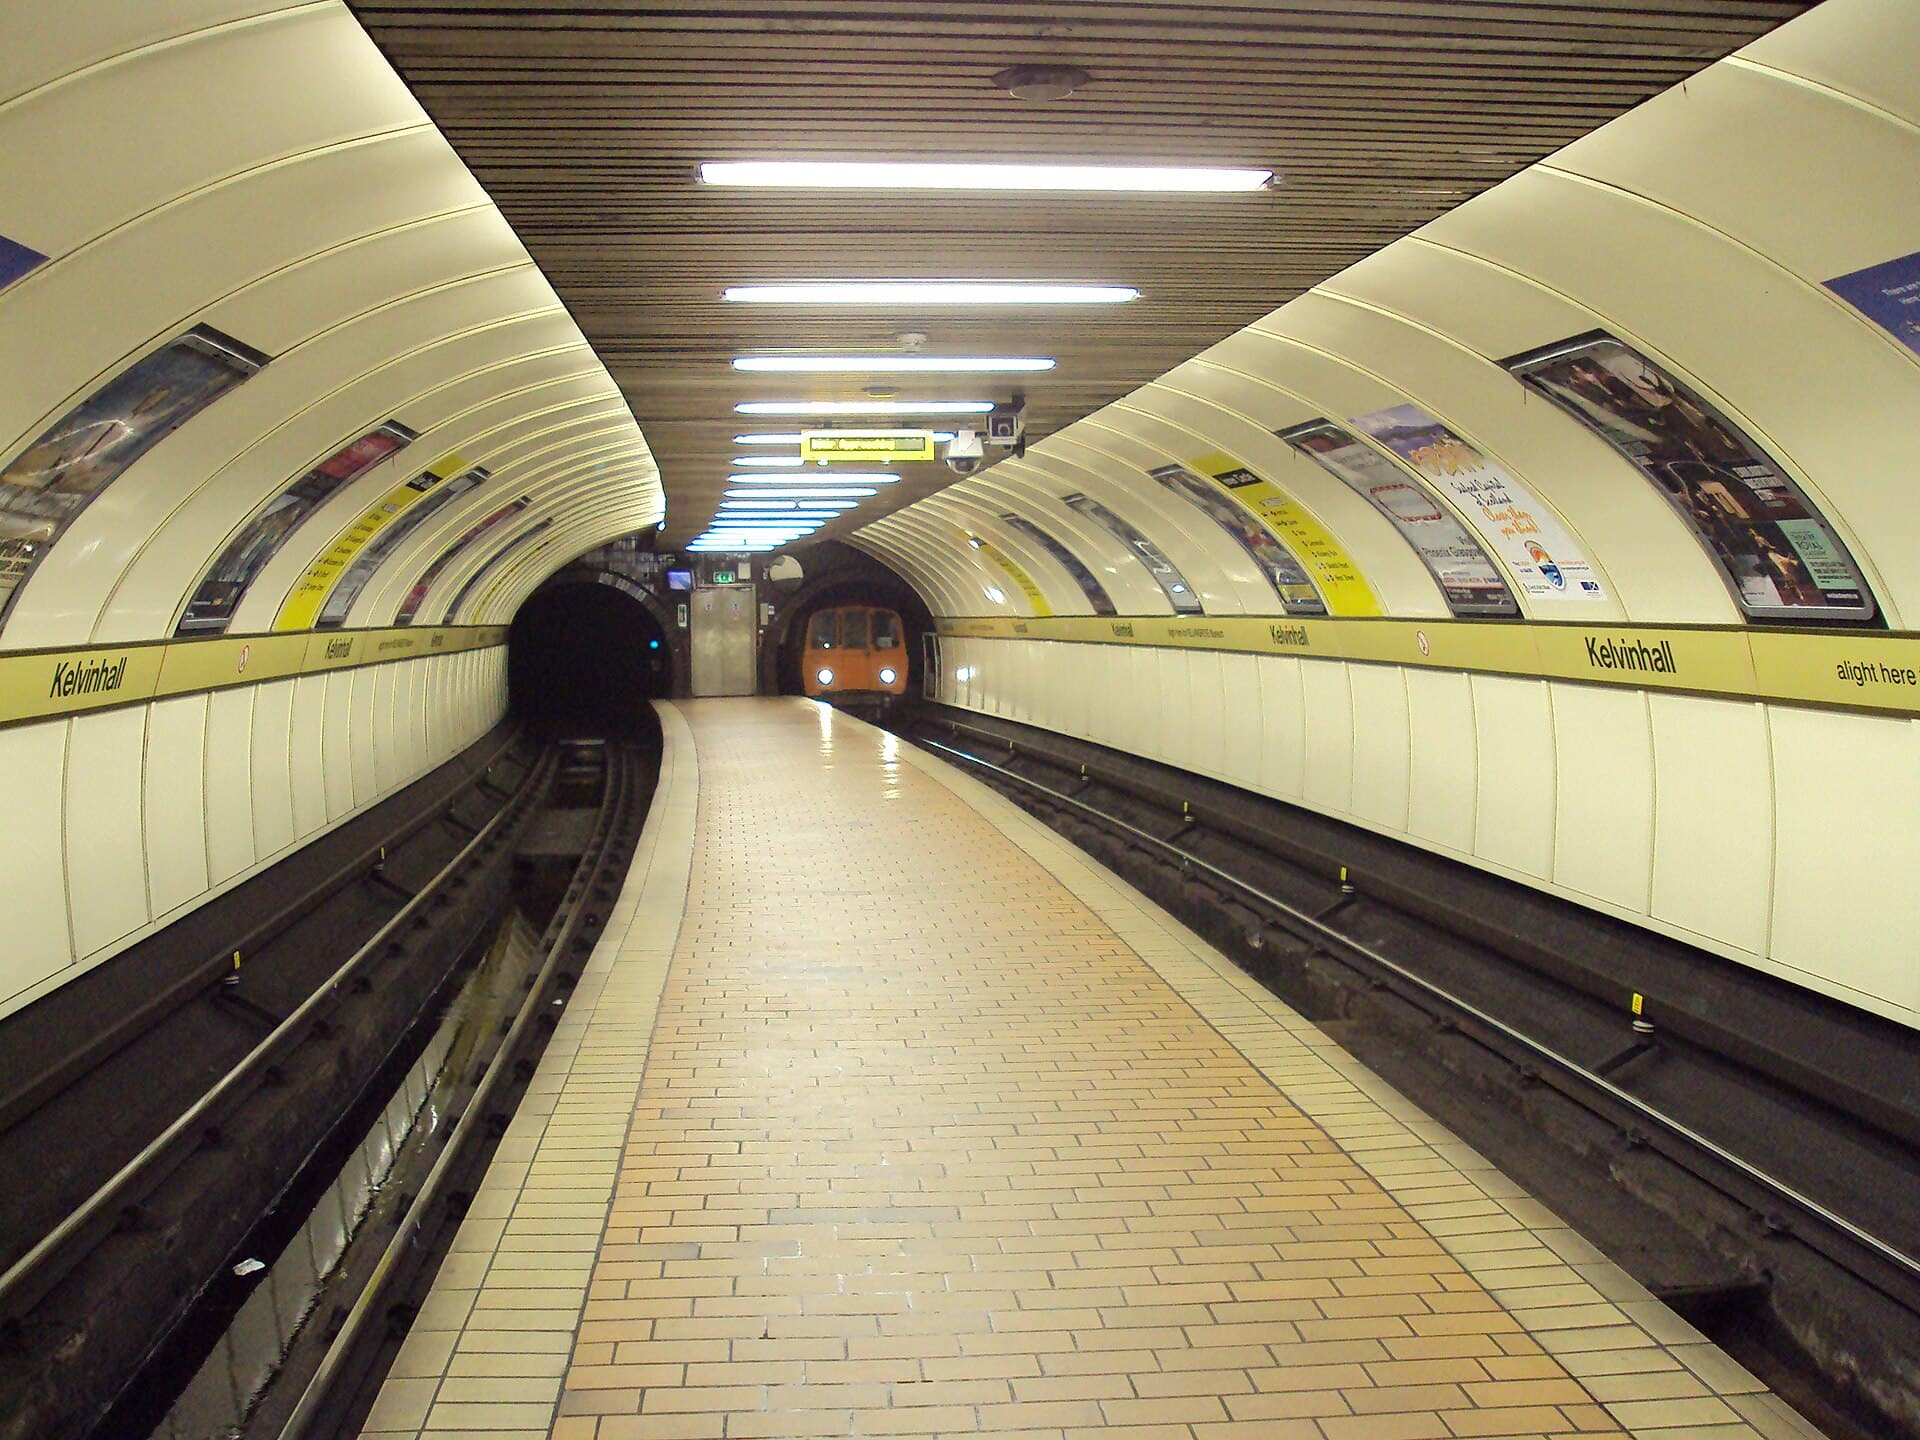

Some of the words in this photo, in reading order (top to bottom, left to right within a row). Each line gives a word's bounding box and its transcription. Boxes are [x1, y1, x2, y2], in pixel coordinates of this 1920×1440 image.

[1270, 624, 1310, 646] Kelvinhall
[1584, 636, 1677, 674] Kelvinhall
[49, 656, 128, 698] Kelvinhall
[1837, 660, 1878, 687] alight
[1880, 663, 1917, 686] here
